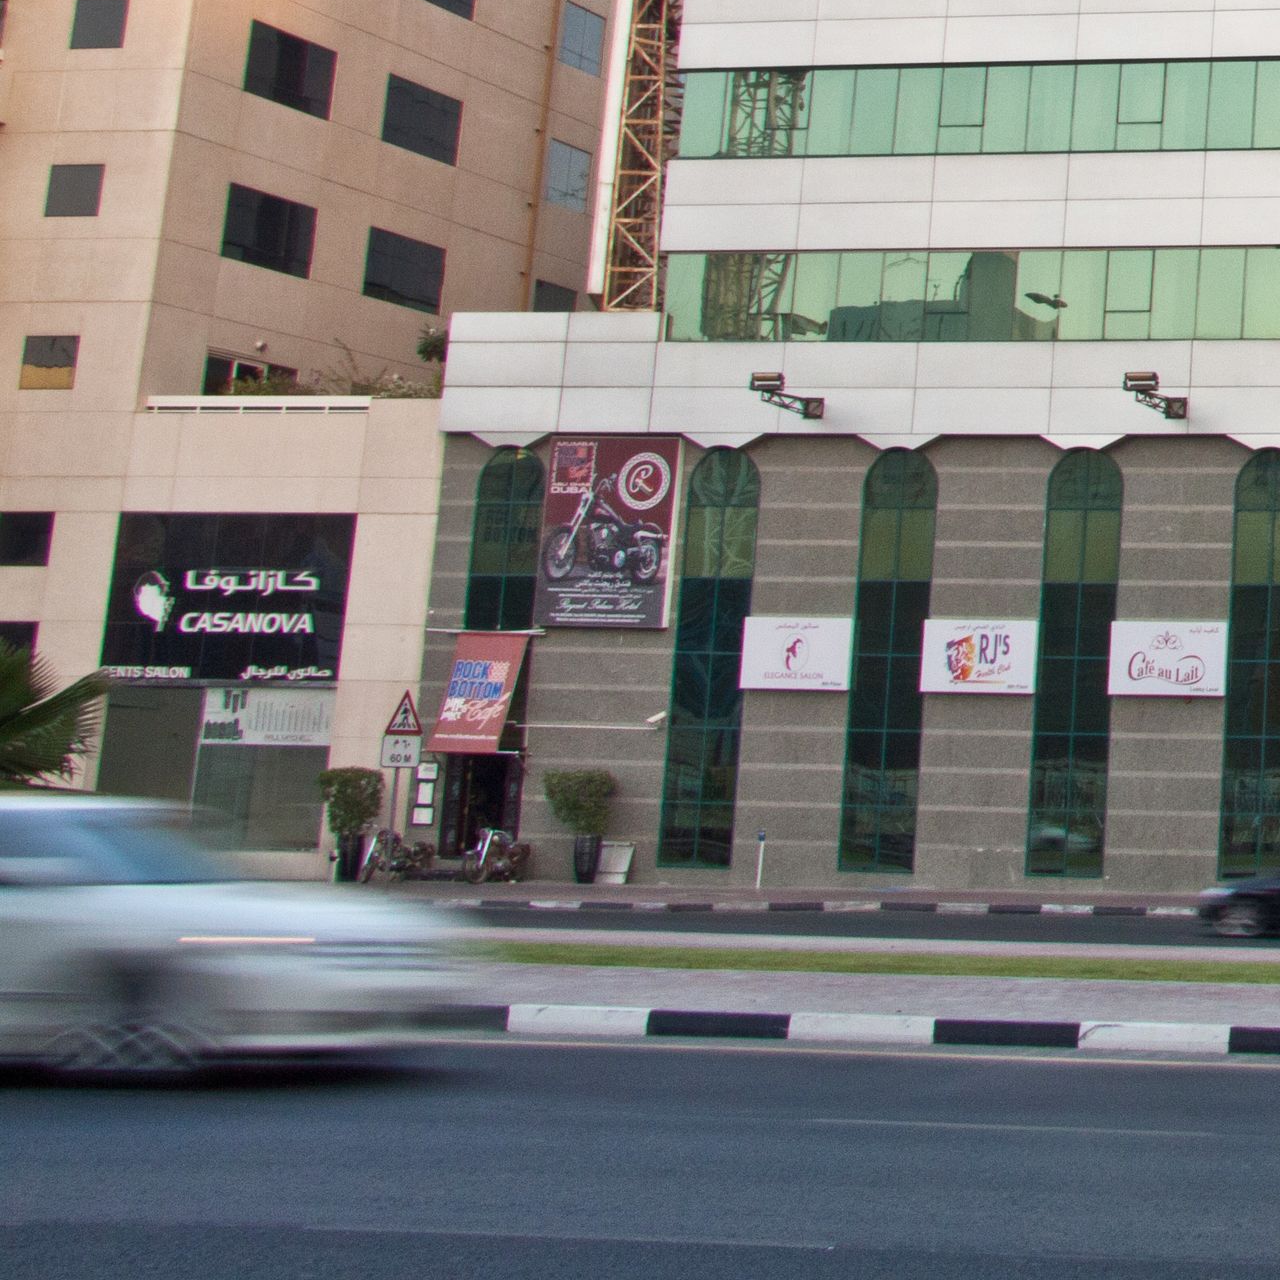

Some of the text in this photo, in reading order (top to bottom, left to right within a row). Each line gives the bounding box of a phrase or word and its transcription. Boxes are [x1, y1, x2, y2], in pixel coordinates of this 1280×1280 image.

[184, 569, 321, 596] كازانوفا
[178, 613, 316, 634] CASANOVA
[144, 665, 192, 679] SALON
[453, 660, 491, 680] ROCK
[448, 680, 505, 699] BOTTOM
[390, 754, 412, 763] 60 M
